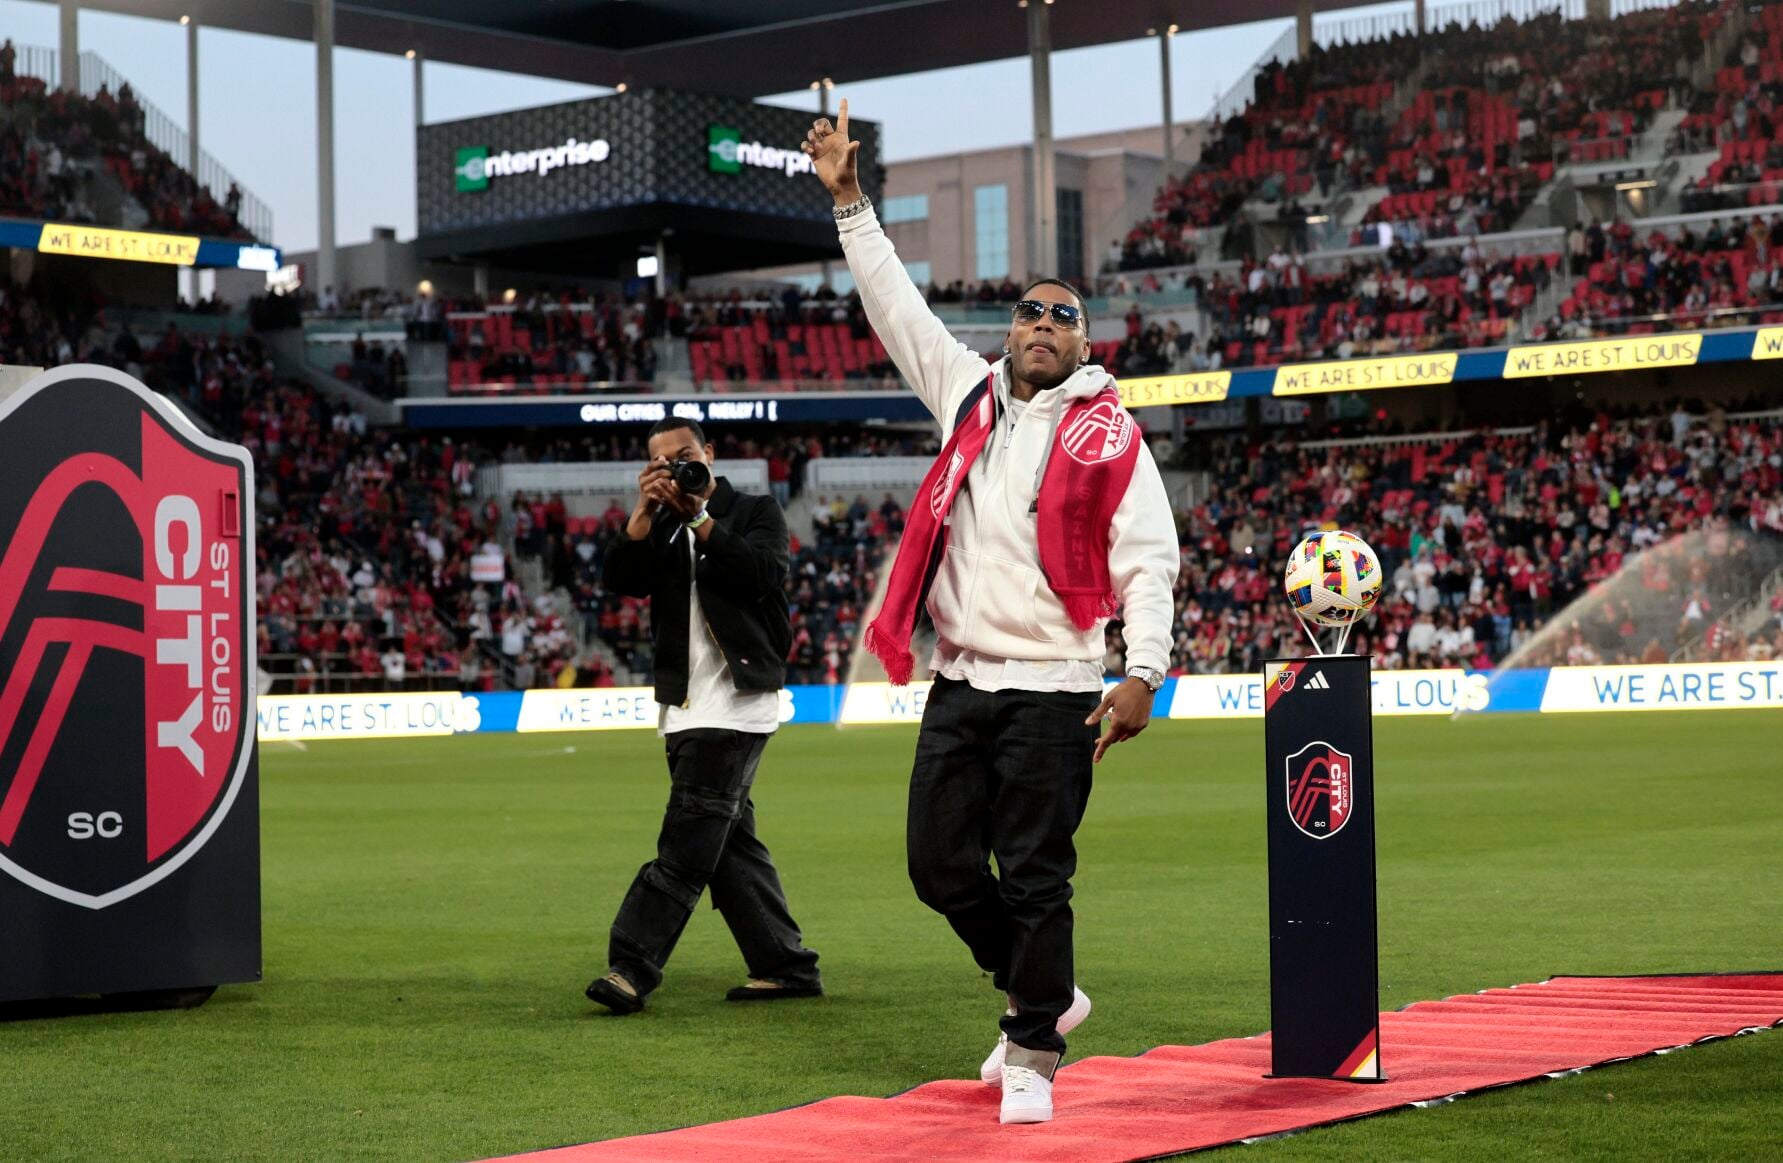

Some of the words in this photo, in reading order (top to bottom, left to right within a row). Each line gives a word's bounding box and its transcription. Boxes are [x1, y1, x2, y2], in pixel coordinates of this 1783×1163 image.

[456, 138, 609, 181] enterprise
[709, 139, 817, 177] enterpr
[82, 235, 111, 251] ARE
[1514, 354, 1544, 371] WE
[1553, 349, 1592, 368] ARE
[1635, 341, 1694, 362] LOUIS
[1174, 379, 1226, 398] LOUIS
[1285, 371, 1311, 388] WE
[1320, 368, 1356, 385] ARE
[1395, 361, 1450, 381] LOUIS
[210, 541, 230, 598] ST
[154, 494, 205, 778] CITY
[211, 612, 231, 733] LOUIS
[1216, 683, 1262, 710] WE
[1593, 674, 1645, 703] WE
[1658, 672, 1725, 702] ARE
[602, 697, 646, 721] ARE
[886, 690, 926, 715] WE
[302, 704, 352, 731] ARE
[1331, 763, 1342, 816] CITY
[67, 811, 123, 840] SC
